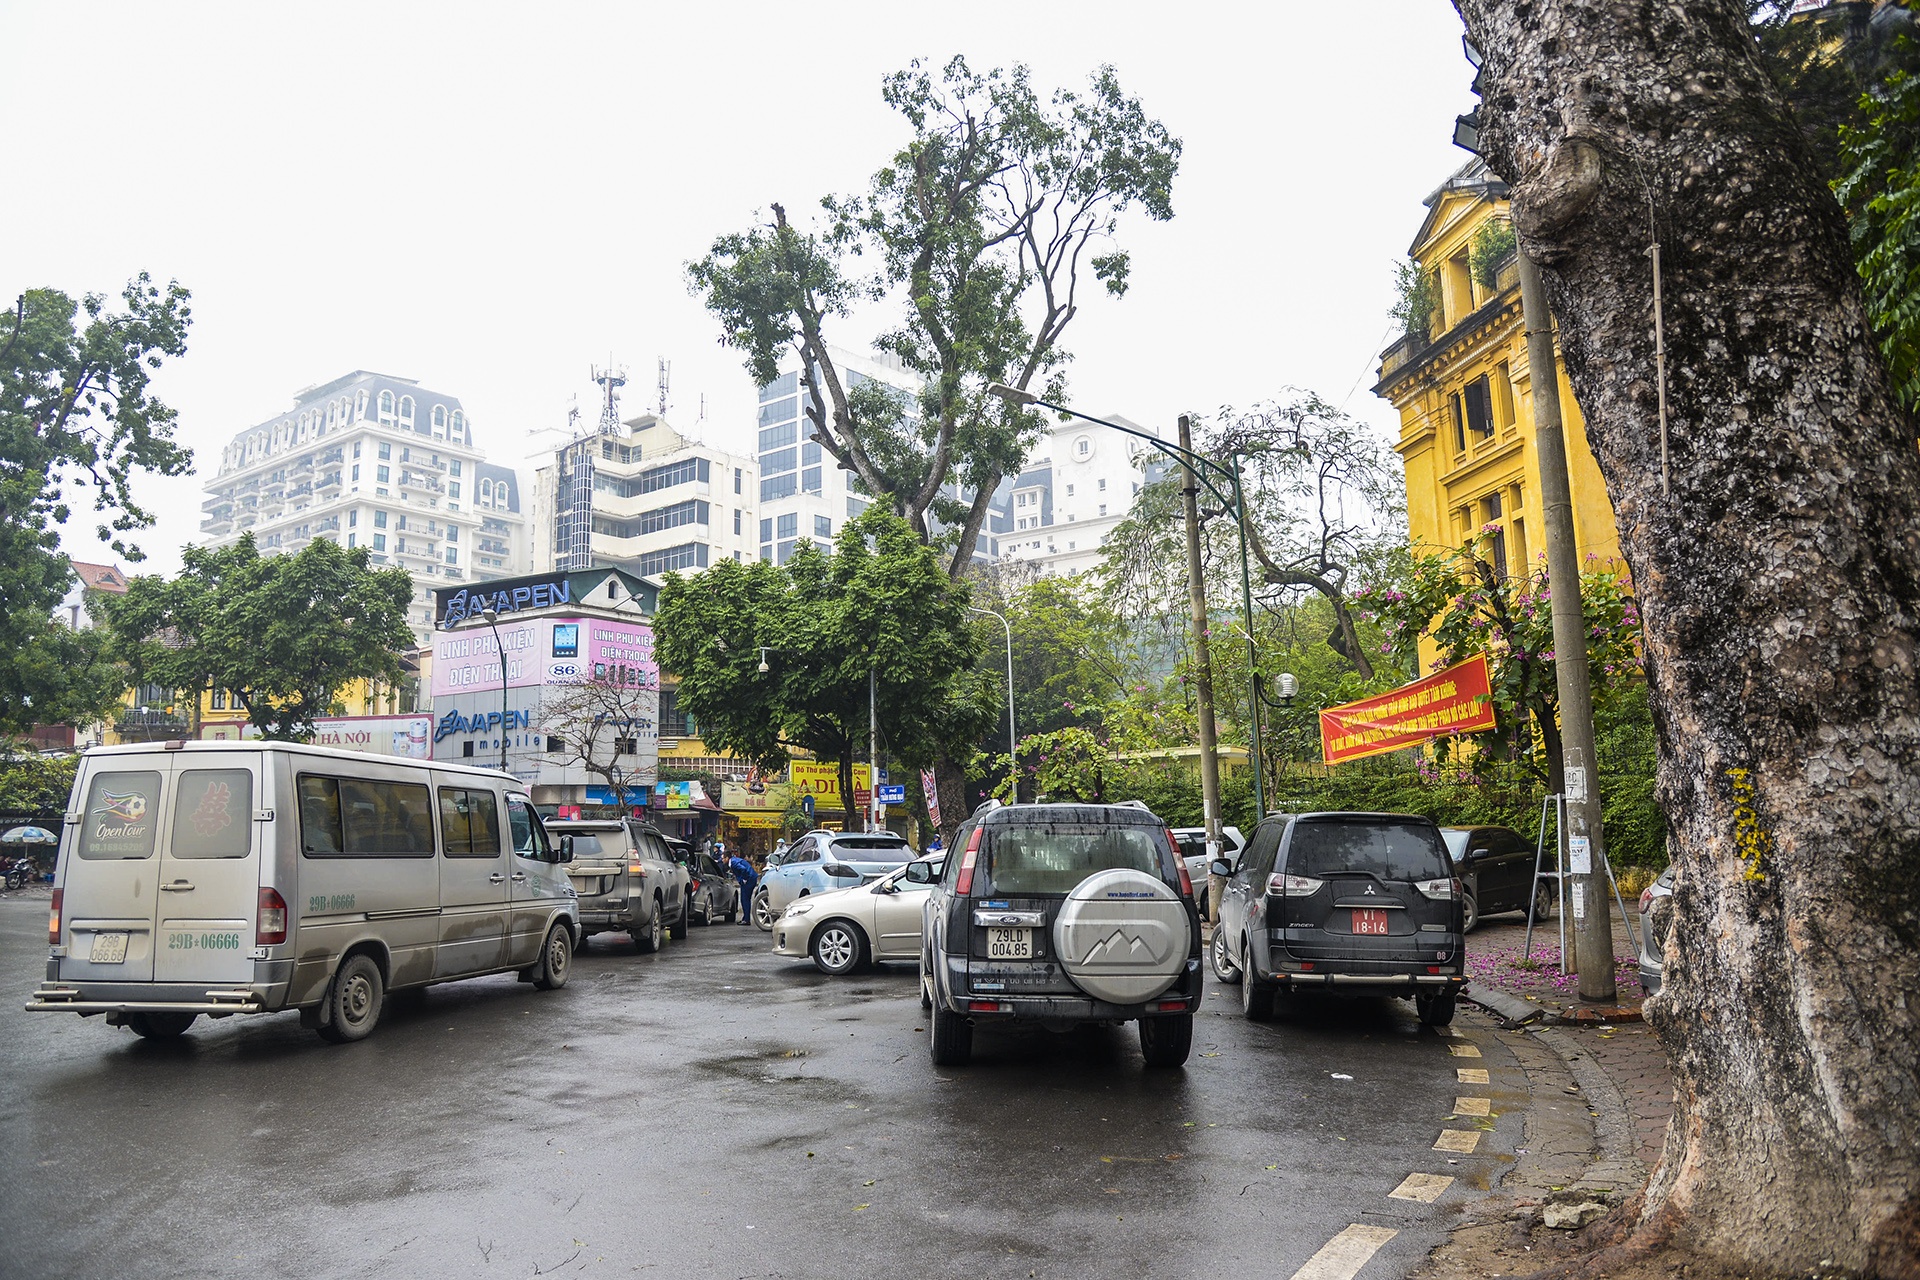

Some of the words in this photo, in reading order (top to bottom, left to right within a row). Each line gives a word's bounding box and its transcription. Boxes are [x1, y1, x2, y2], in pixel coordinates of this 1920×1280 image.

[440, 639, 470, 660] LINH
[473, 633, 500, 657] PHỤ
[503, 626, 535, 653] KIỆN
[594, 629, 614, 642] LINH
[616, 631, 633, 647] PHỤ
[601, 645, 622, 660] ĐIỆN
[624, 649, 648, 664] THOẠI
[449, 663, 480, 689] ĐIỆN
[553, 665, 576, 676] 86
[434, 709, 529, 743] BAVAPEN
[321, 730, 341, 745] HÀ
[345, 729, 371, 747] NỘI
[479, 734, 540, 750] mobile
[1362, 909, 1376, 921] VT
[1355, 922, 1386, 933] 18-16
[100, 935, 120, 948] 29B
[996, 929, 1023, 942] 29LD
[91, 948, 124, 962] 066.66
[991, 943, 1028, 956] 004.85
[1436, 951, 1447, 960] 08
